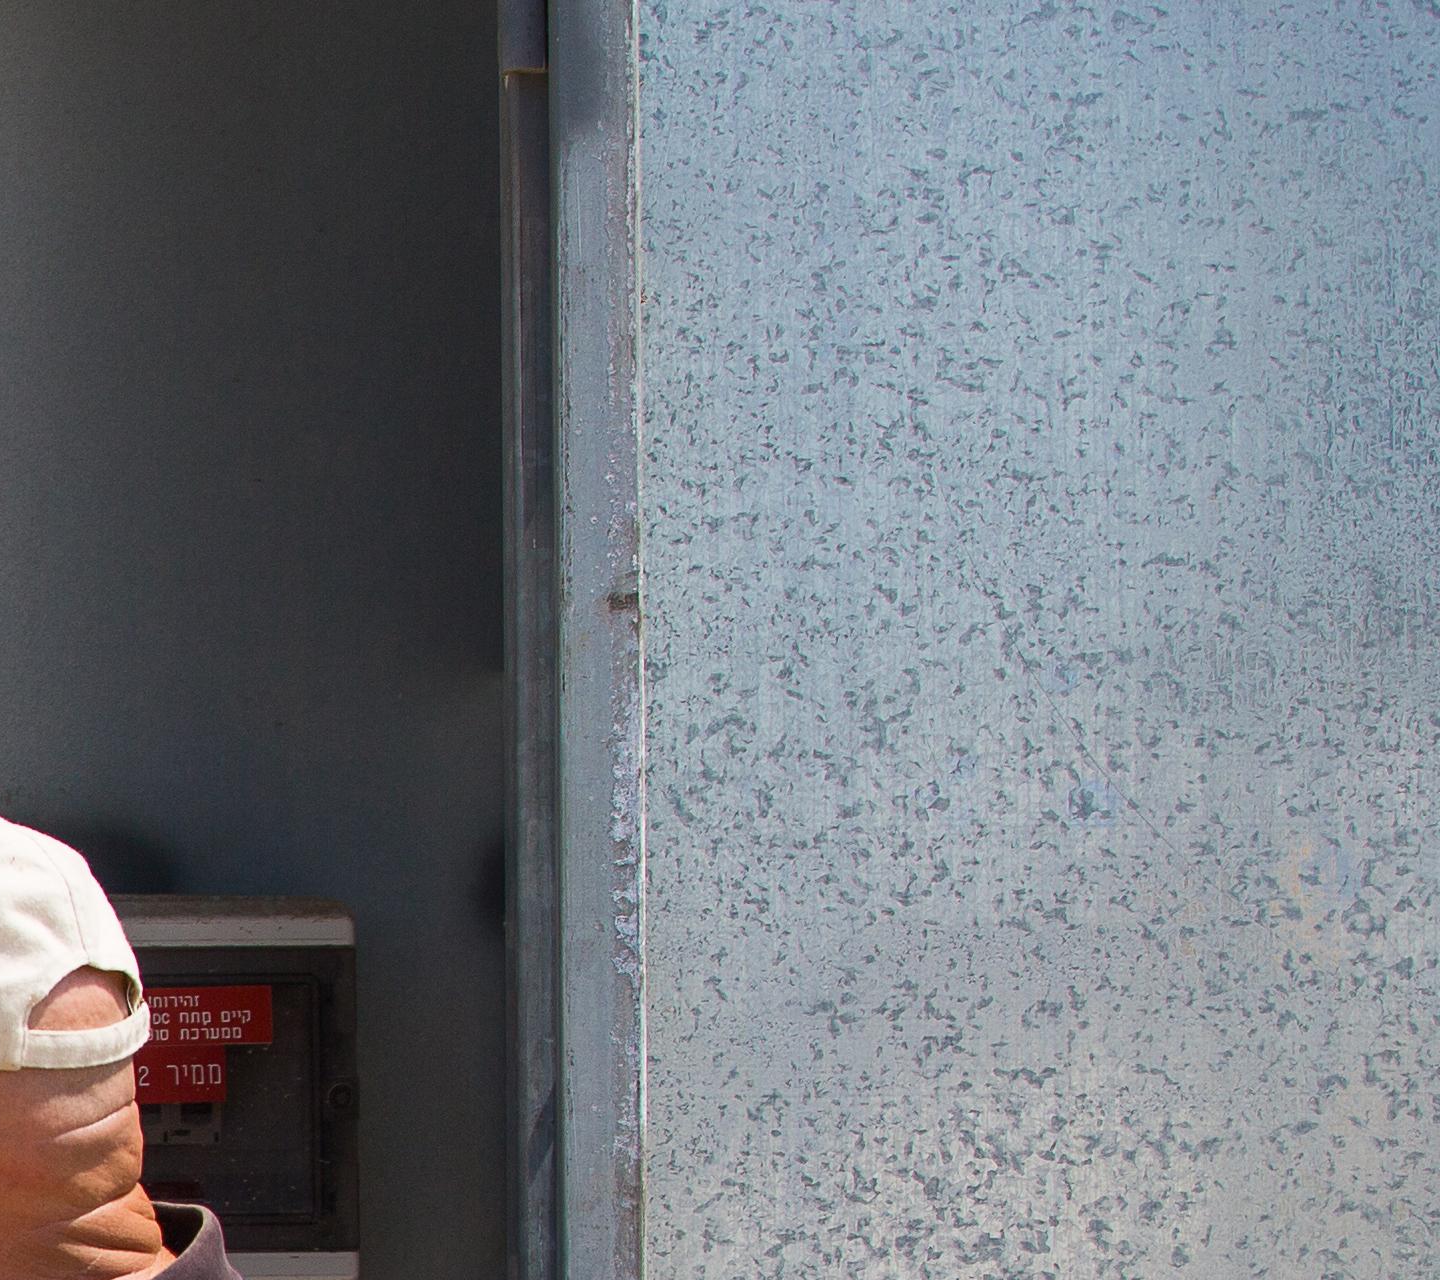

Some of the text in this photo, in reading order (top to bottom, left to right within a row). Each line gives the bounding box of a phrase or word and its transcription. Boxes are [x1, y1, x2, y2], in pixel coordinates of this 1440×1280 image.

[152, 1010, 251, 1025] קיים מתח DC
[180, 1026, 242, 1040] ממערכת
[138, 1063, 221, 1087] ממיר 2
